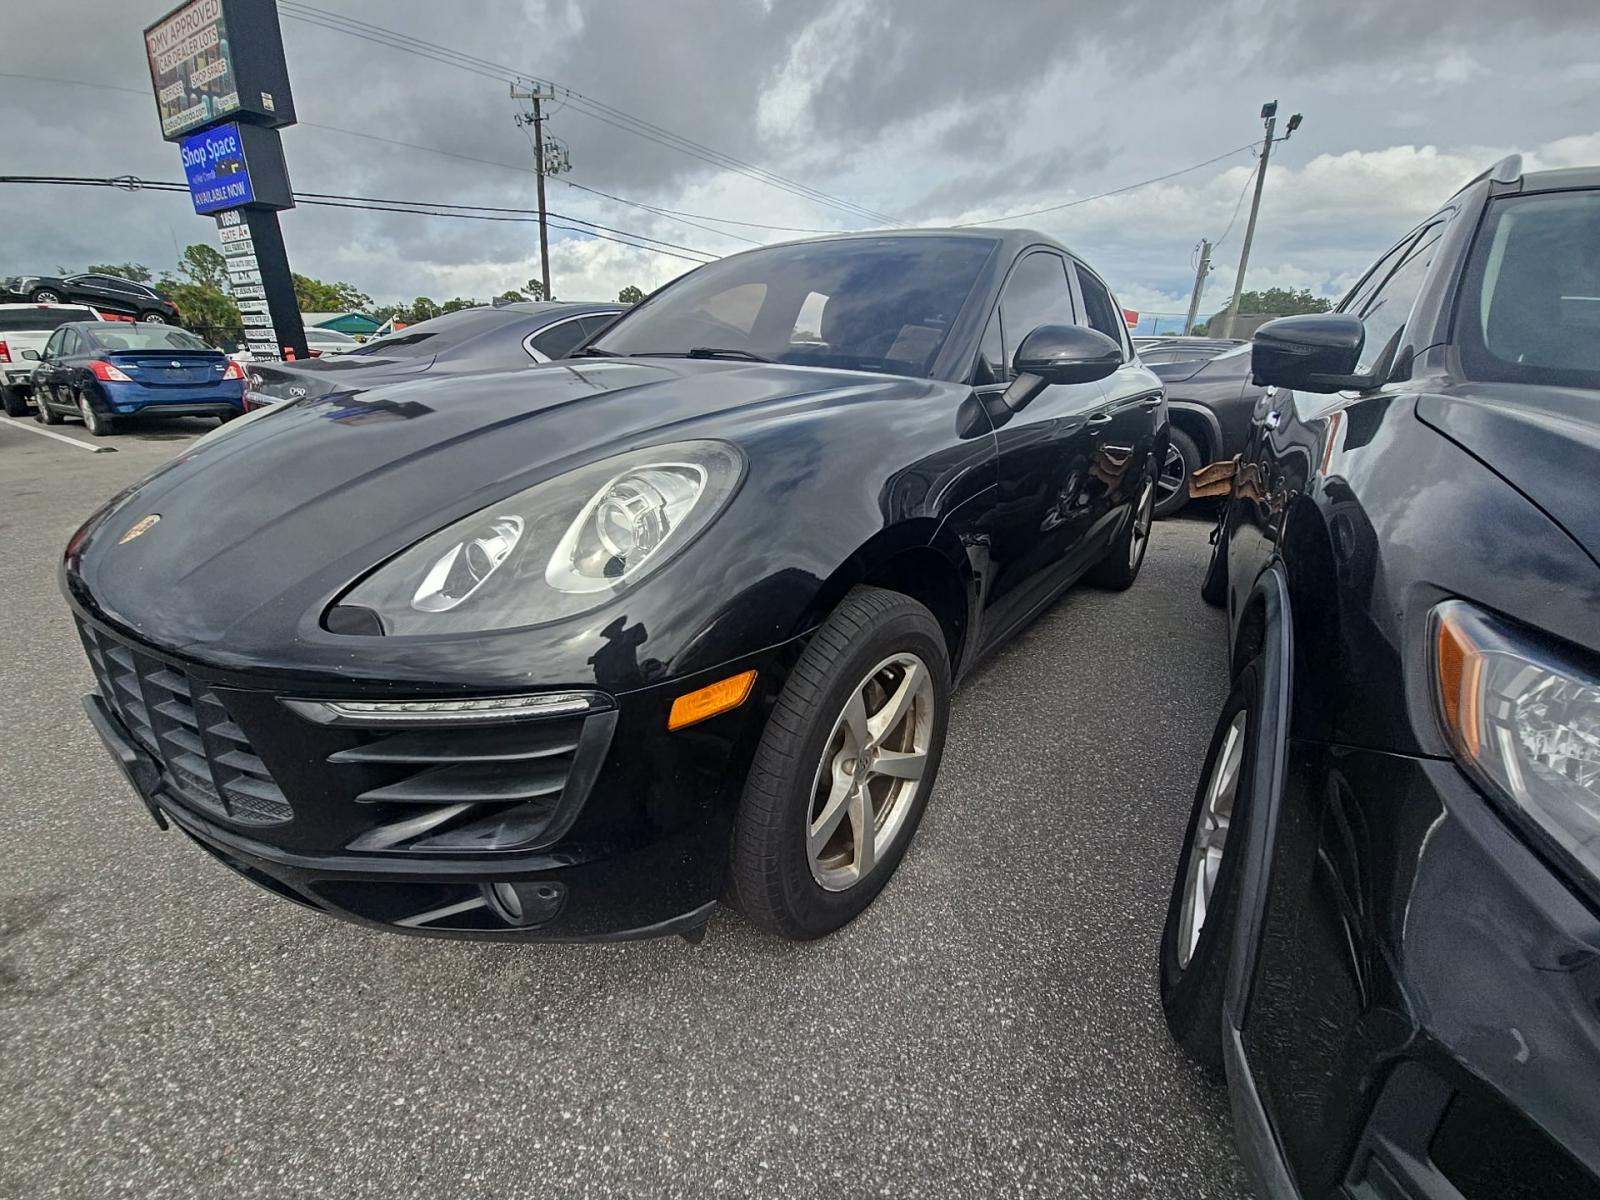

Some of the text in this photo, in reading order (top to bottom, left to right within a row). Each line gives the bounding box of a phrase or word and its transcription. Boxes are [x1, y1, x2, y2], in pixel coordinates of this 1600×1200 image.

[150, 0, 219, 54] DMV APPROVED
[172, 40, 198, 64] DEALER
[198, 28, 218, 49] LOTS
[191, 60, 226, 87] SHOP SPACE
[182, 136, 236, 168] Shop Space
[194, 181, 246, 207] AVAILABLE NOW
[222, 228, 236, 242] GATE
